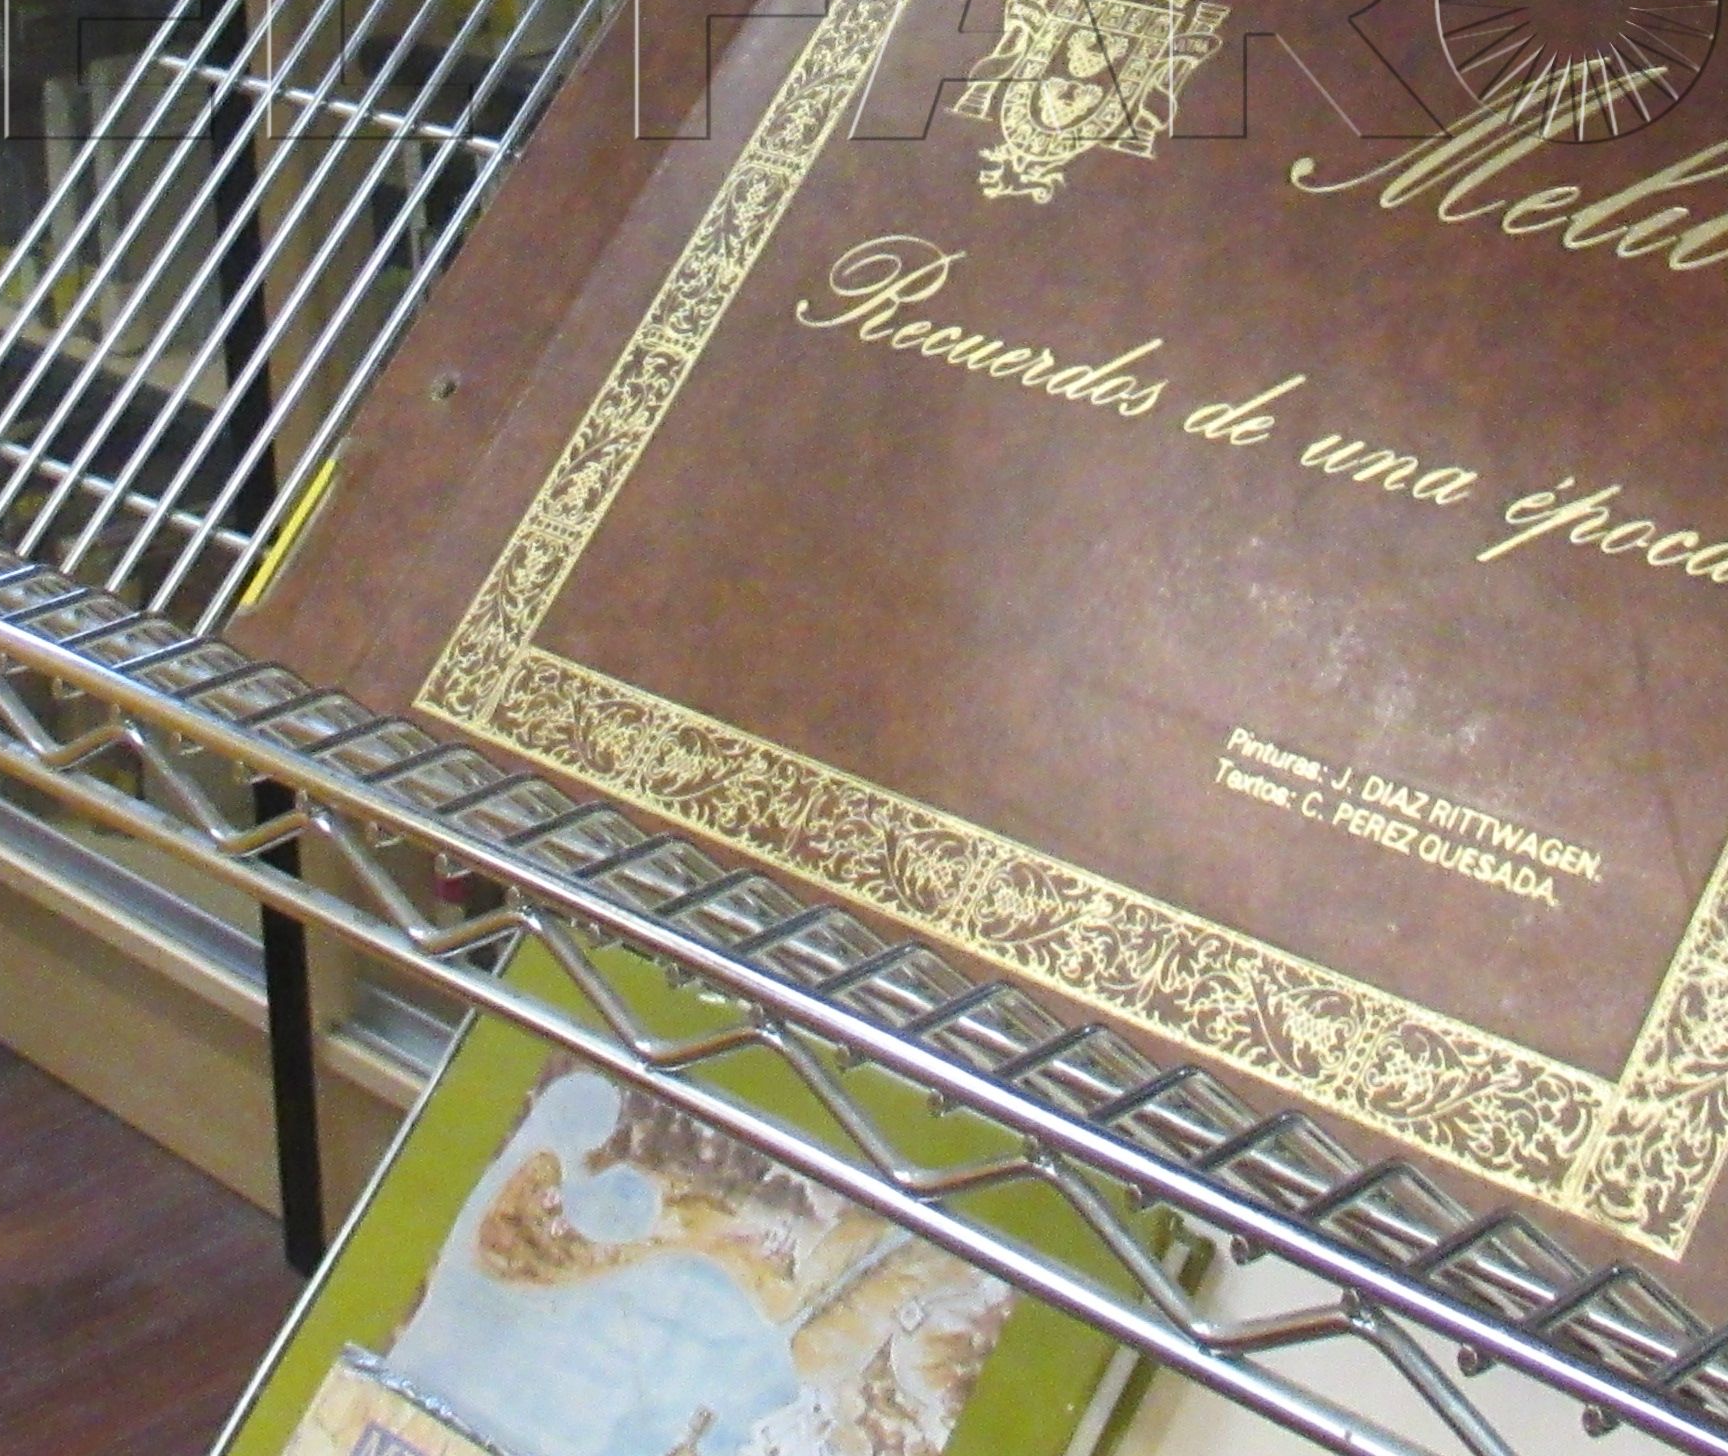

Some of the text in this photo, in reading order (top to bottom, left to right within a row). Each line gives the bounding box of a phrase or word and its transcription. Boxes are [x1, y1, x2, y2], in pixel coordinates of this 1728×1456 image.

[795, 234, 1169, 417] Recuerdos
[1183, 374, 1306, 446] de
[1300, 434, 1478, 505] una
[1214, 757, 1562, 908] Textos: C. PEREZ QUESADA.
[1226, 727, 1603, 883] Pinturas: J. DIAZ RITTWAGEN.
